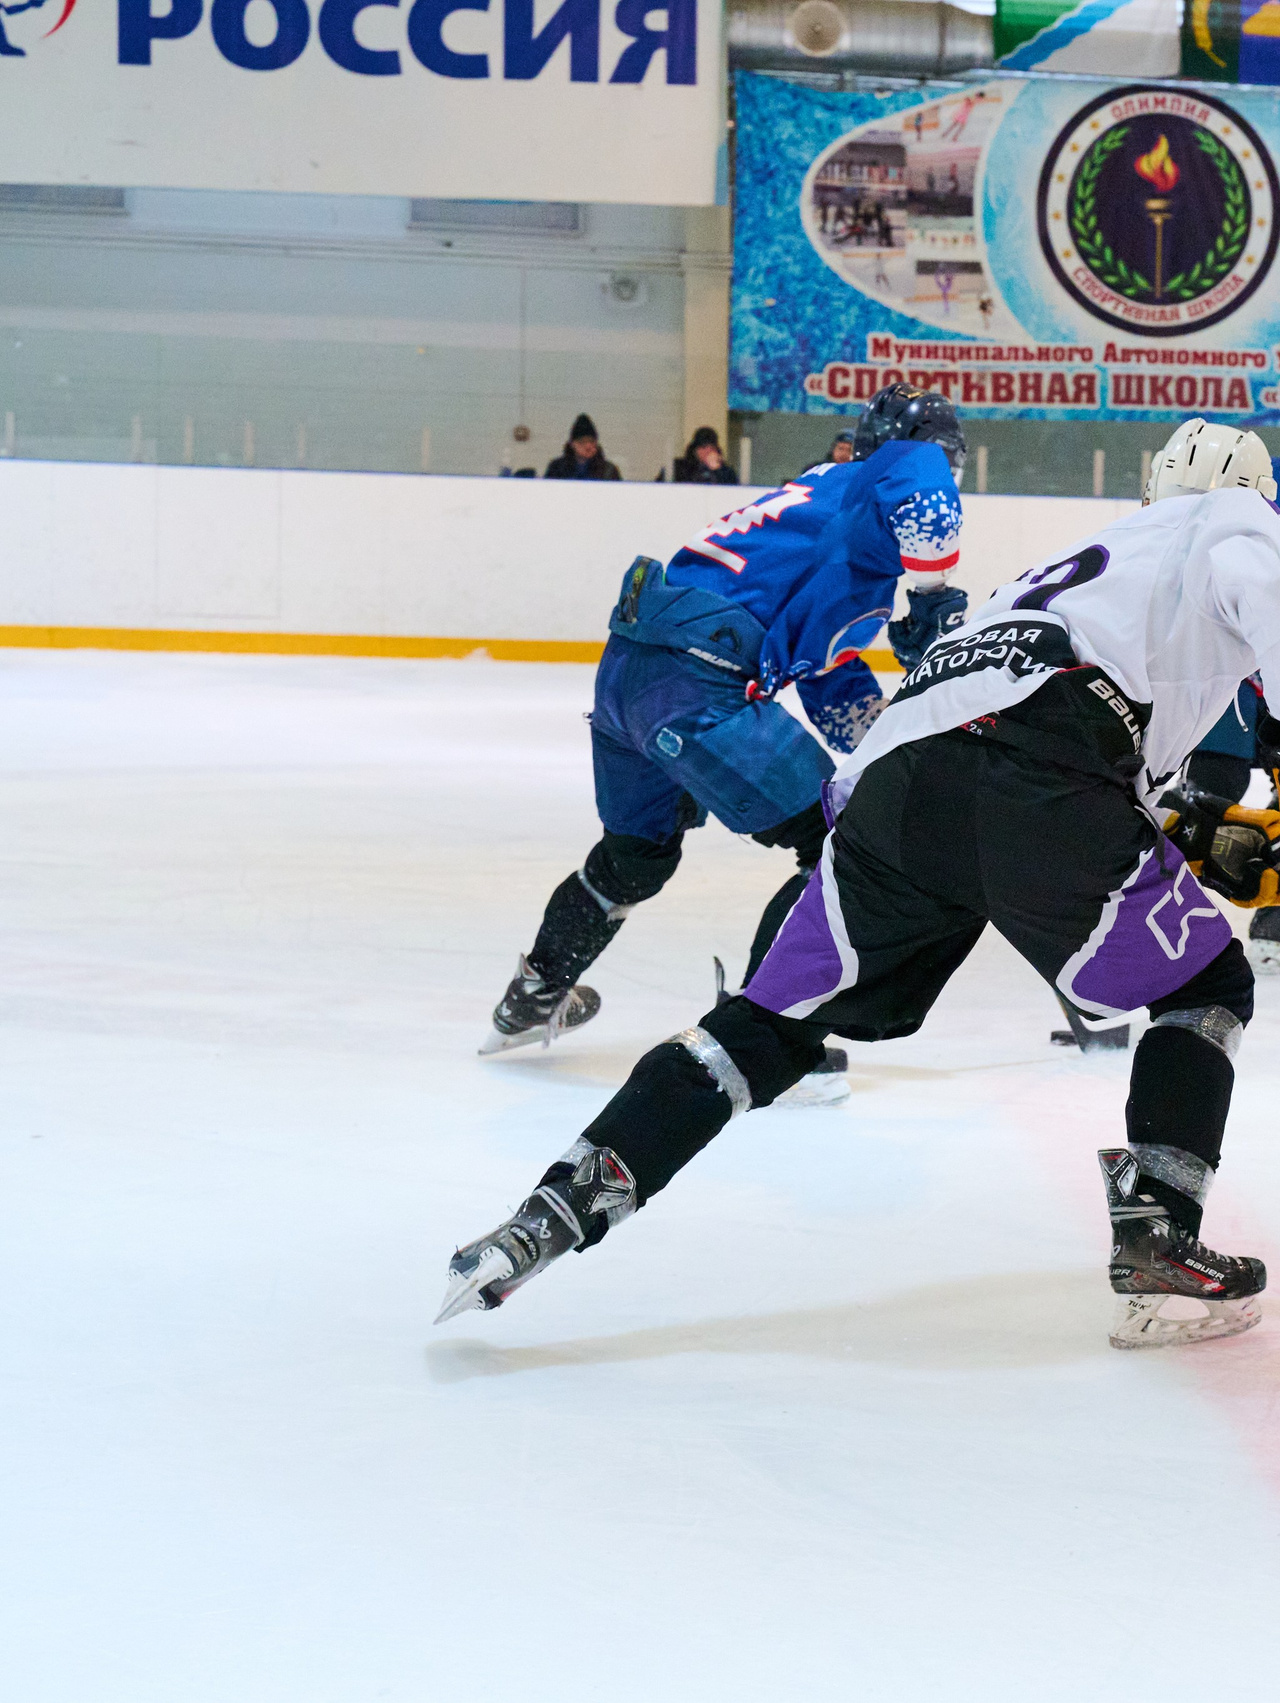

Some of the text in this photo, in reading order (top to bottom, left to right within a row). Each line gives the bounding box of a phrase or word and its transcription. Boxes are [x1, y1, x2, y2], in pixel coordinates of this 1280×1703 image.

[117, 0, 698, 86] РОССИЯ
[1111, 96, 1210, 122] ОЛИМПИЯ
[1073, 267, 1244, 322] СПОРТИВНАЯ ШКОЛА
[871, 337, 1094, 364] Муниципального
[1103, 342, 1266, 368] Автономного
[1112, 374, 1249, 409] ШКОЛА
